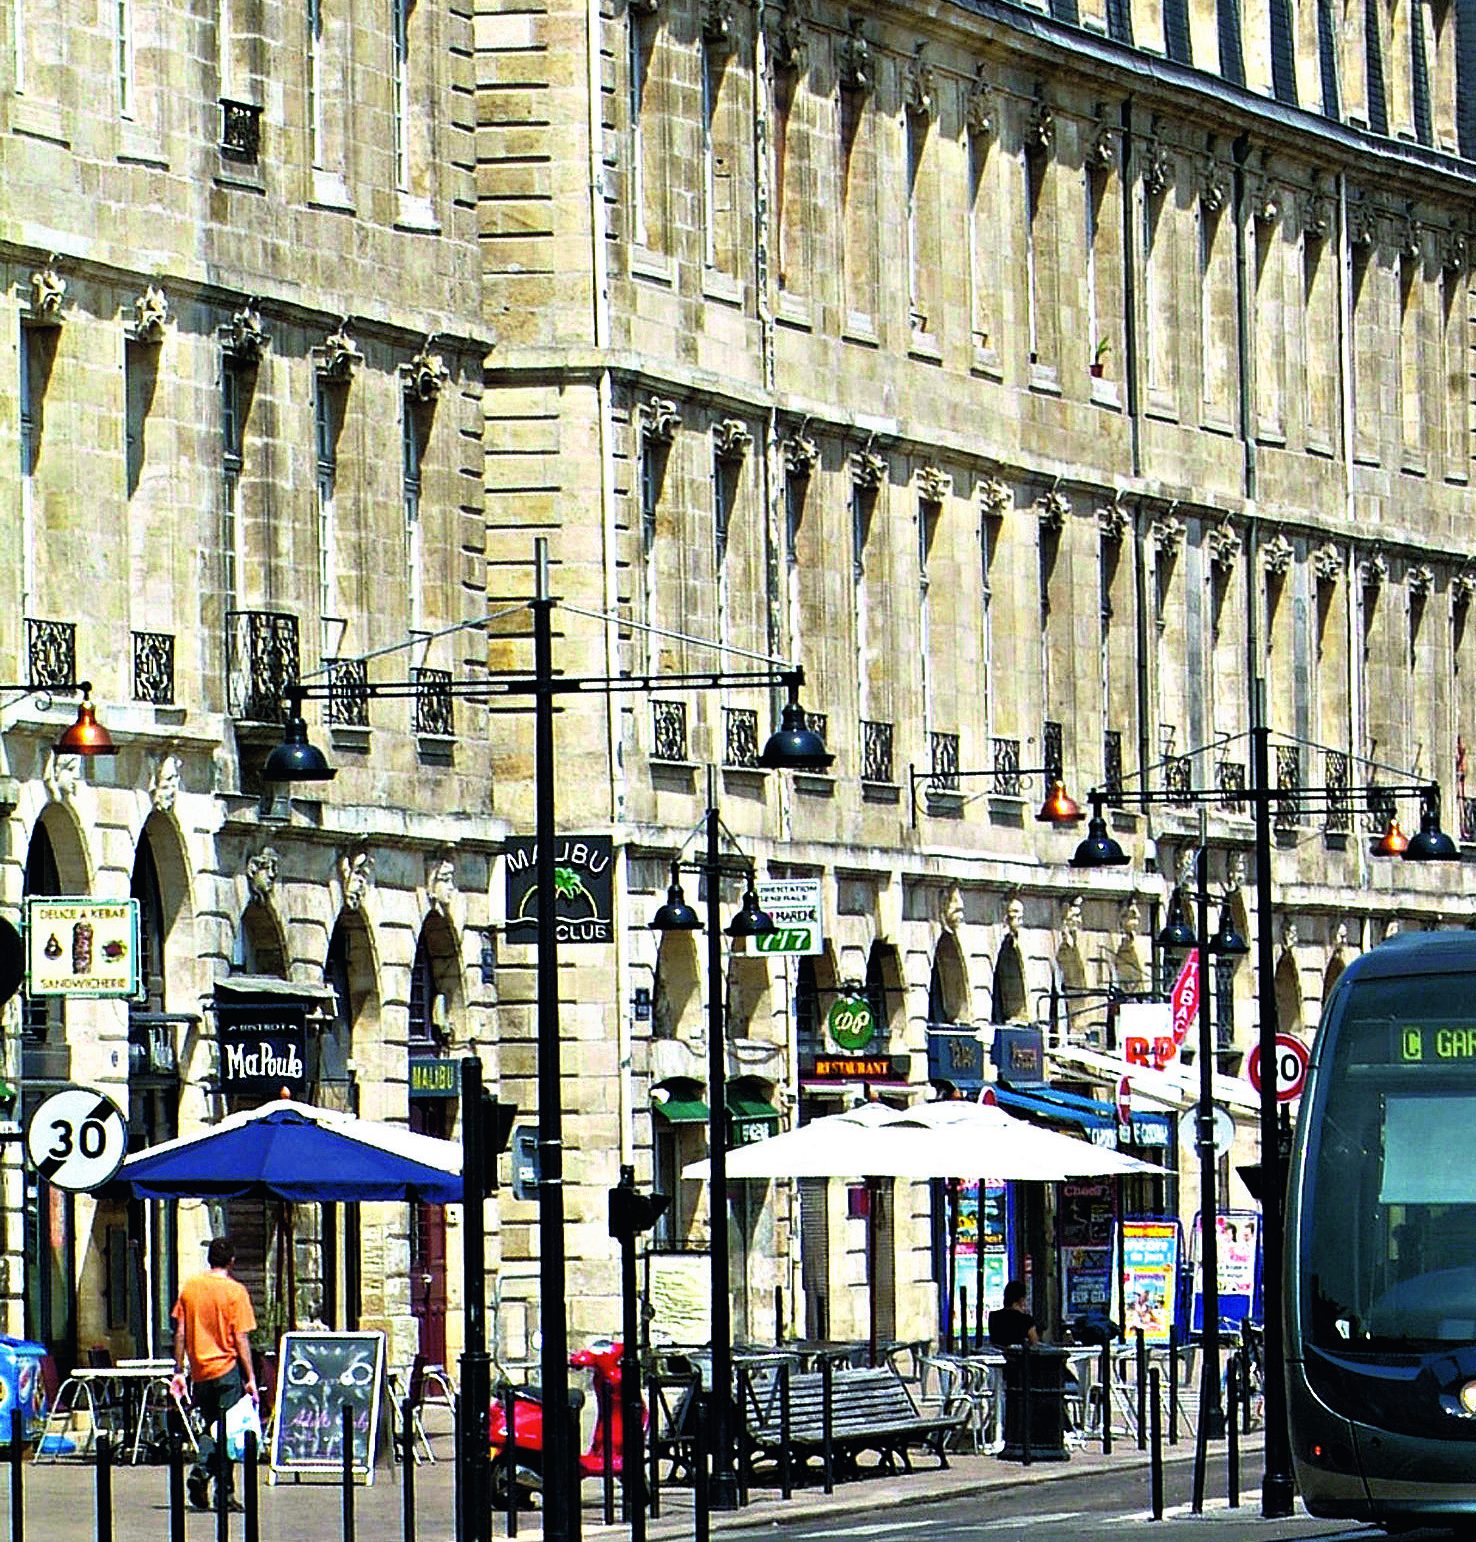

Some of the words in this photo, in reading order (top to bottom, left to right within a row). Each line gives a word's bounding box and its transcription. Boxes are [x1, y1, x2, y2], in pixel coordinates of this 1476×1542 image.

[556, 924, 607, 941] CLUB
[1173, 962, 1200, 1033] TABAC
[412, 1066, 455, 1091] MALIBU
[816, 1061, 889, 1075] RESTAURANT
[49, 1119, 106, 1159] 30
